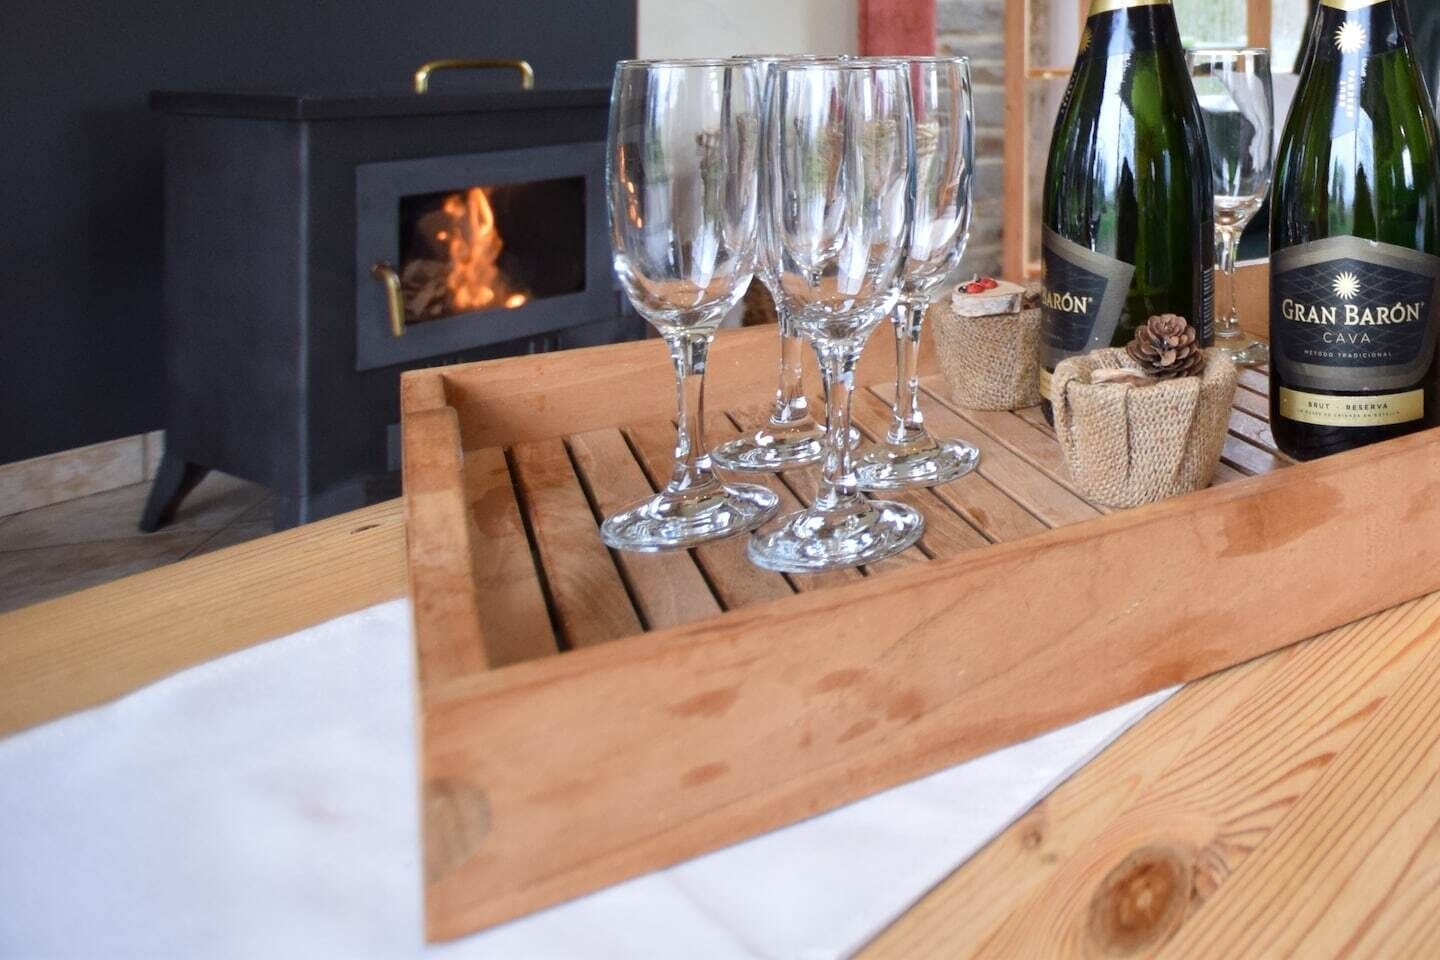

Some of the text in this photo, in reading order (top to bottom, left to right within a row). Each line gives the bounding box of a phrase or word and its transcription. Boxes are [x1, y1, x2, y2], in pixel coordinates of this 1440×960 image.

[1282, 298, 1420, 326] GRAN BARÓN
[1323, 331, 1371, 344] CAVA
[1337, 351, 1392, 359] TRADICIONAL
[1307, 401, 1388, 411] BRUT RESERVA
